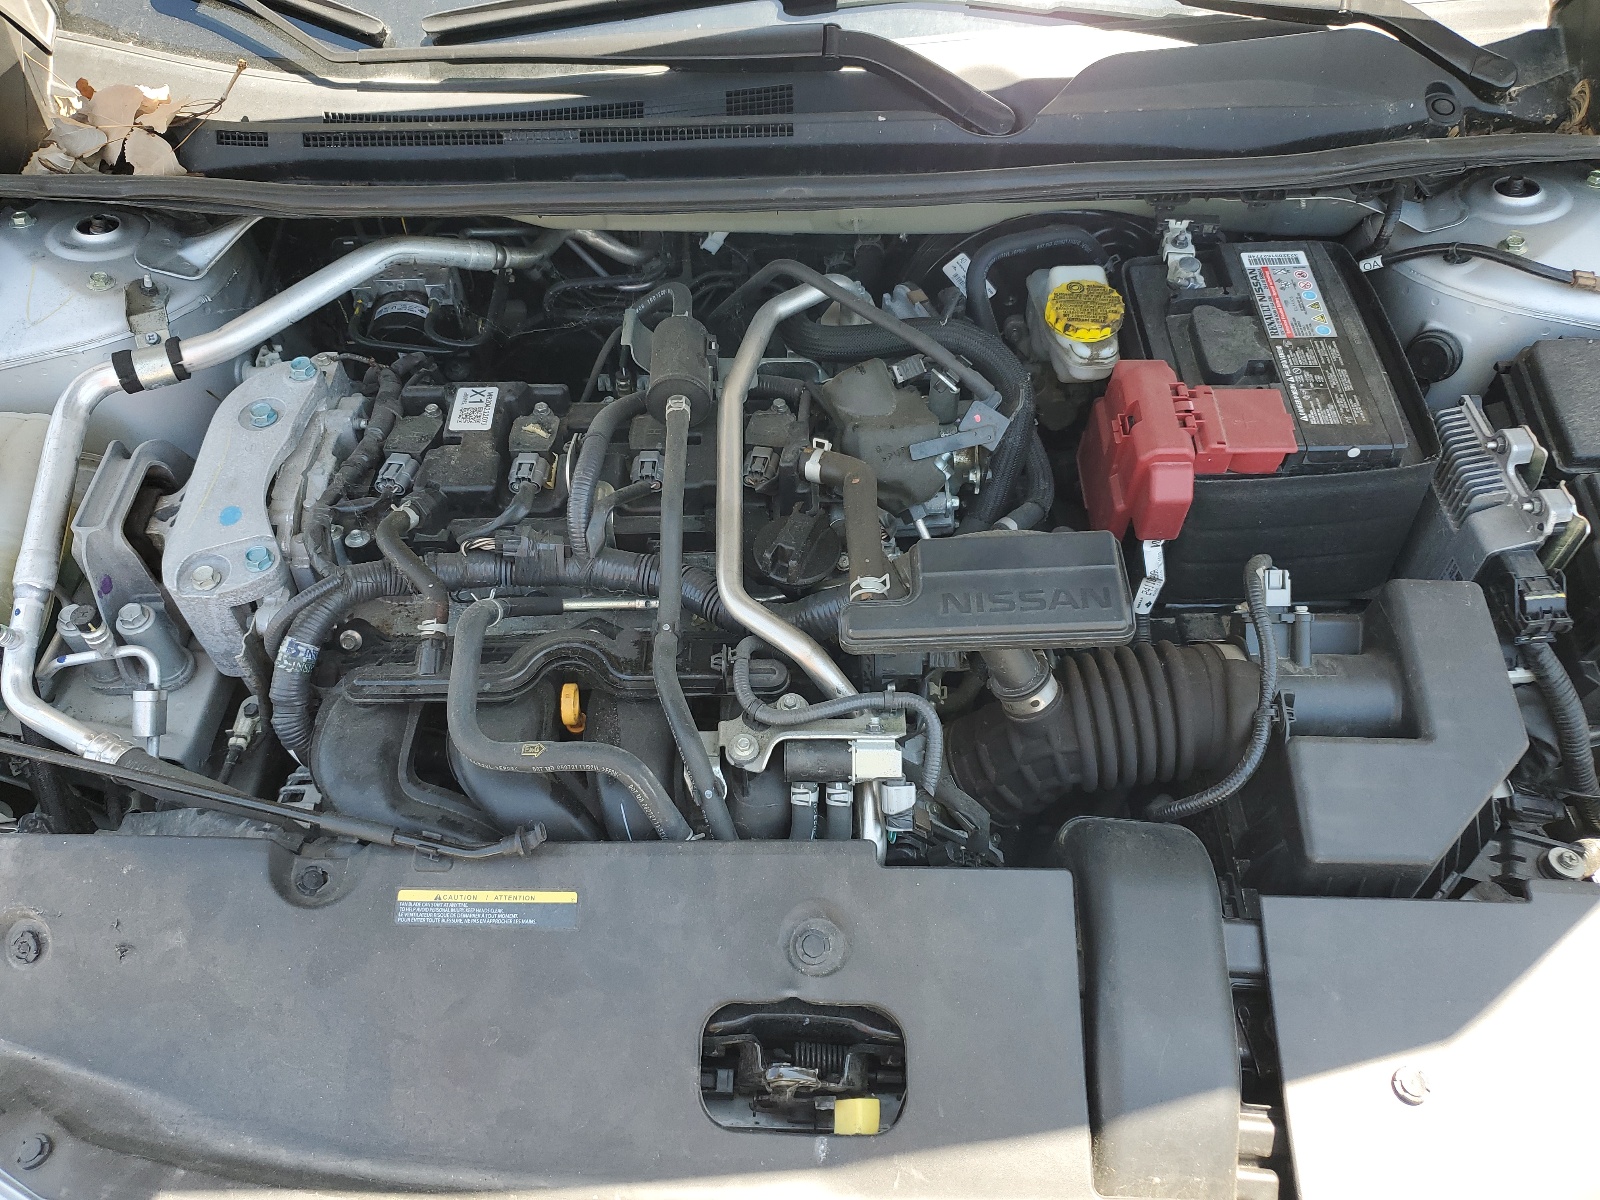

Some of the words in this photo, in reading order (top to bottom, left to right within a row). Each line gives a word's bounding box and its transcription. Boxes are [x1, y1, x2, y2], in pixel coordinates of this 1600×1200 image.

[1247, 268, 1267, 302] NISSAN
[1260, 303, 1280, 336] RENAULT
[468, 389, 487, 403] X1
[940, 587, 1114, 615] NISSAN
